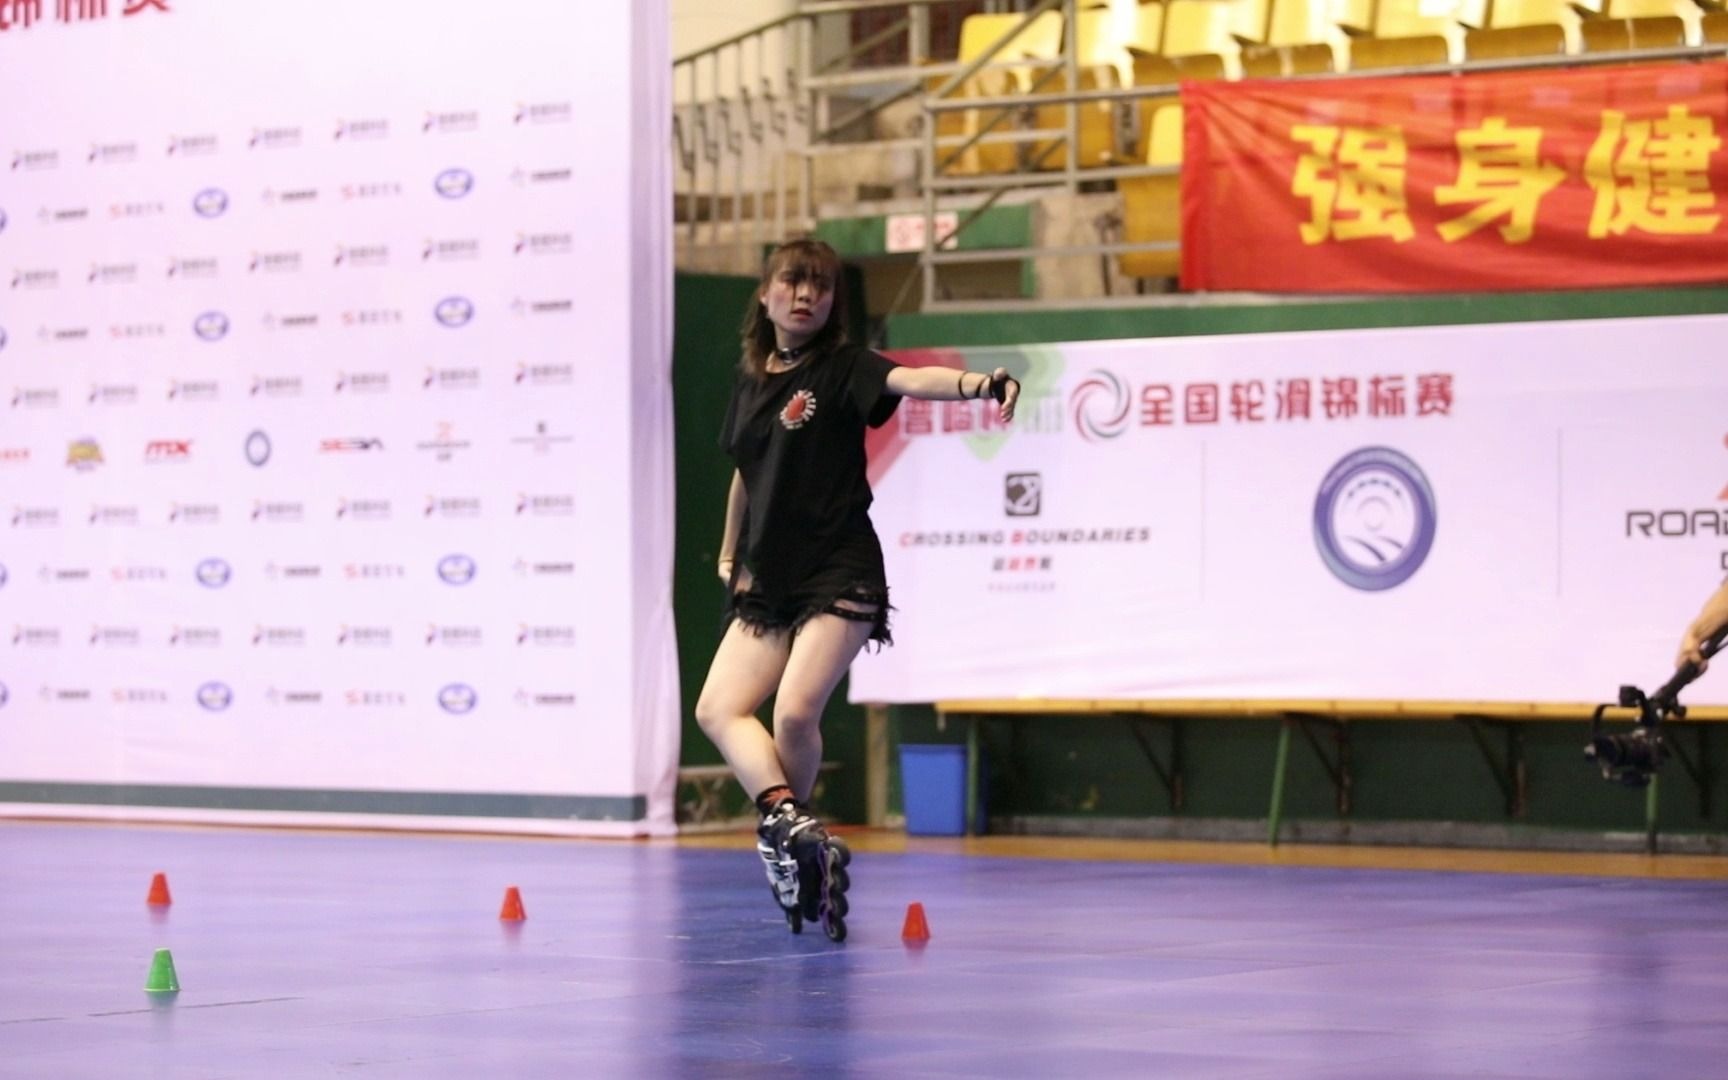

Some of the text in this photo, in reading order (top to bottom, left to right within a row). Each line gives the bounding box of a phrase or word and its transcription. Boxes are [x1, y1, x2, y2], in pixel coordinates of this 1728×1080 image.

[1290, 103, 1724, 246] 强身健
[1140, 372, 1454, 426] 全国轮滑锦标赛
[899, 526, 1152, 548] CROSSING BOUNDARIES
[1625, 510, 1728, 538] ROA
